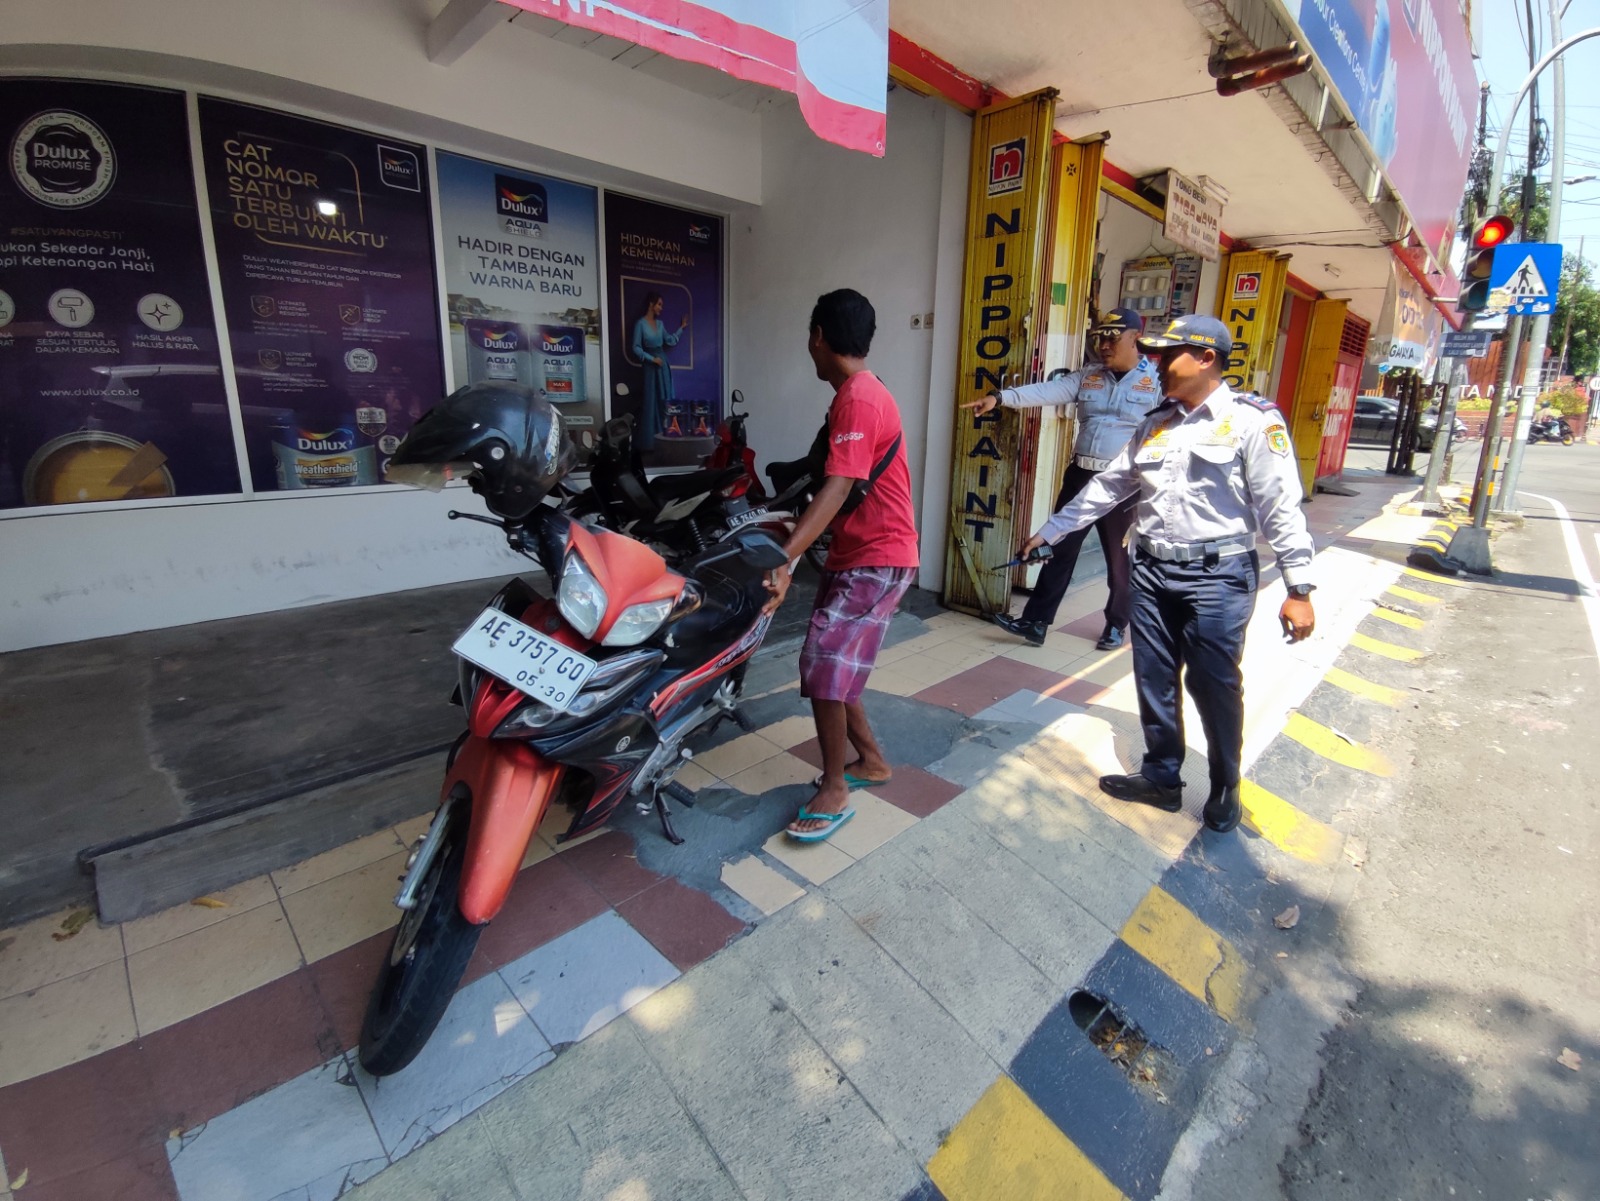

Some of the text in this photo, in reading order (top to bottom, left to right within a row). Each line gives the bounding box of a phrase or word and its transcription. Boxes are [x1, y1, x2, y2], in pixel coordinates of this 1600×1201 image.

[33, 142, 91, 160] Dulux
[223, 139, 272, 162] CAT
[34, 159, 92, 171] PROMISE
[384, 162, 411, 175] Dulux
[226, 157, 320, 190] NOMOR
[228, 176, 292, 200] SATU
[229, 194, 347, 227] TERBUKTI
[501, 197, 539, 216] Dulux
[233, 212, 299, 236] OLEH
[505, 218, 542, 231] AQUA
[1195, 210, 1218, 231] JAYA
[505, 226, 542, 238] SHIELD
[688, 229, 709, 239] Dulux
[620, 232, 681, 253] HIDUPKAN
[40, 242, 104, 255] Sekedar
[110, 246, 151, 260] Janji,
[458, 235, 585, 267] HADIR DENGAN
[620, 245, 695, 267] KEMEWAHAN
[21, 255, 117, 271] Ketenangan
[122, 260, 155, 273] Hati
[478, 255, 574, 281] TAMBAHAN
[469, 271, 582, 297] WARNA BARU
[975, 207, 1021, 390] NIPPON
[72, 331, 105, 339] SEBAR
[72, 339, 117, 347] TERTULIS
[135, 334, 194, 343] HASIL AKHIR
[35, 346, 120, 355] DALAM KEMASAN
[132, 341, 165, 349] HALUS
[175, 343, 200, 351] RATA
[484, 338, 515, 350] Dulux
[543, 342, 571, 353] Dulux
[486, 356, 518, 364] AQUA
[40, 388, 140, 397] www.dulux.co.id
[297, 437, 348, 451] Dulux
[294, 461, 358, 475] Weathershield
[730, 516, 742, 528] AE
[480, 616, 511, 641] AE
[508, 630, 559, 666] 3757
